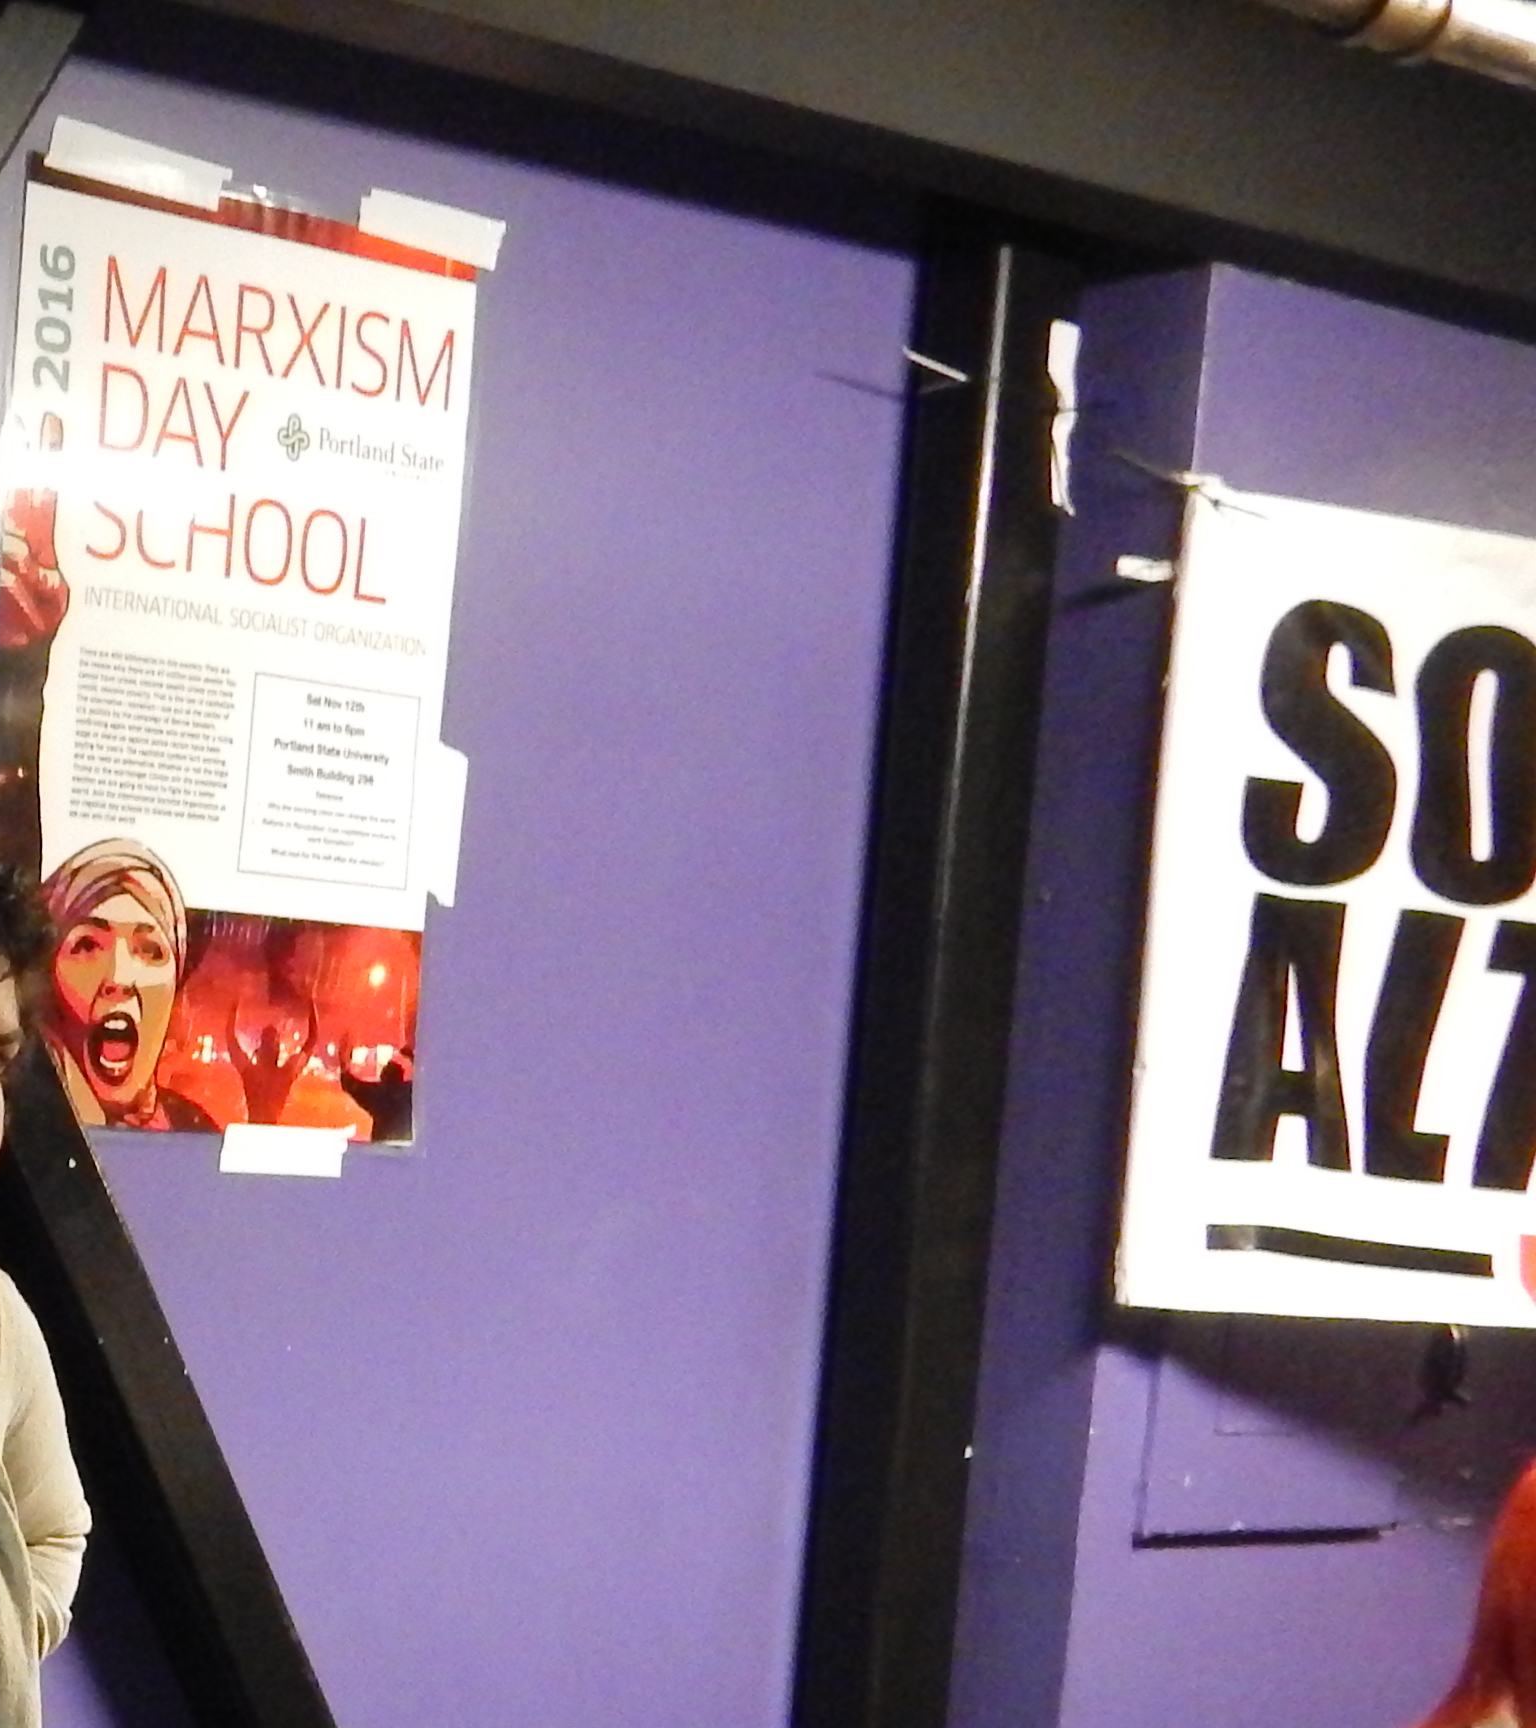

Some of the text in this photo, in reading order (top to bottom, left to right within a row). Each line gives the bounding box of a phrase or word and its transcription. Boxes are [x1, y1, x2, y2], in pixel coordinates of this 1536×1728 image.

[33, 244, 76, 392] 2016
[102, 254, 456, 412] MARXISM
[97, 363, 250, 471] DAY
[319, 427, 445, 472] Portland State
[85, 494, 387, 606] SCHOOL
[84, 585, 428, 658] INTERNATIONAL SOCIALIST ORGANIZATION
[324, 696, 343, 710] Nov
[274, 738, 390, 766] Portland State University
[287, 764, 355, 786] Smith Building
[1239, 598, 1536, 907] SO
